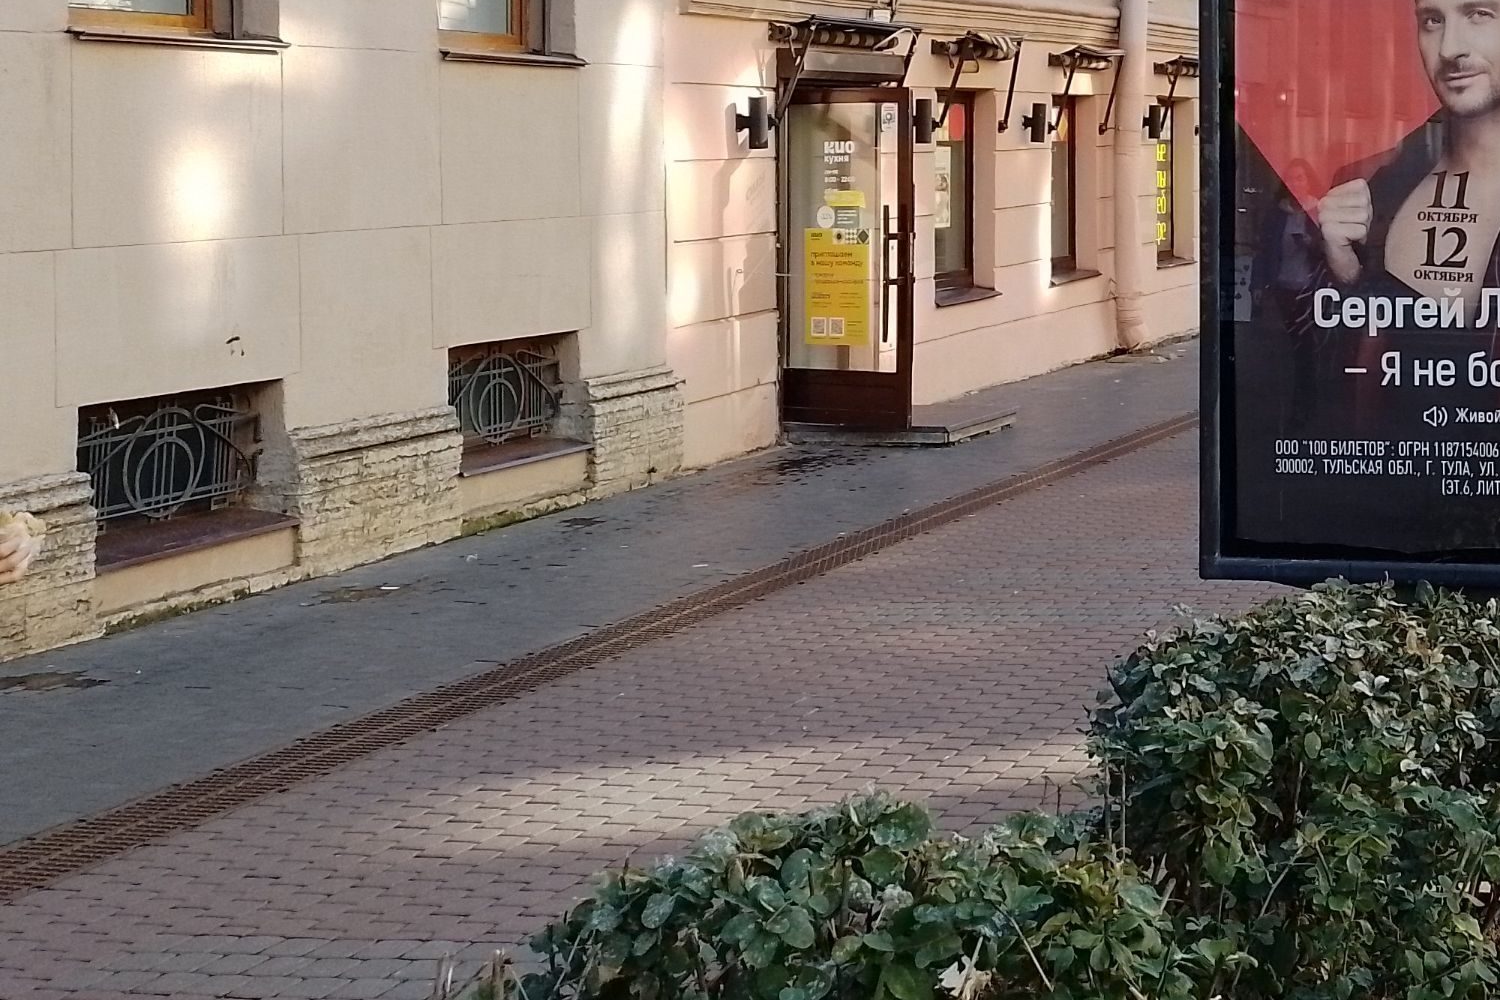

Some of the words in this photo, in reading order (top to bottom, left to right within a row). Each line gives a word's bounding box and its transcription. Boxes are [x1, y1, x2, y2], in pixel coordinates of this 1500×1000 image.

[1426, 170, 1470, 210] 11
[1417, 211, 1479, 223] ОКТЯБРЯ
[1420, 226, 1468, 268] 12
[1413, 269, 1474, 282] ОКТЯБРЯ
[1313, 287, 1465, 337] Сергей
[1380, 352, 1401, 387] Я
[1413, 358, 1456, 387] не
[1275, 440, 1299, 455] ООО
[1398, 442, 1430, 457] ОГРН
[1275, 458, 1318, 476] 300002,
[1322, 459, 1383, 475] ТУЛЬСКАЯ
[1388, 460, 1421, 477] ОБЛ.,
[1425, 461, 1436, 475] Г.
[1440, 461, 1474, 478] ТУЛА,
[1479, 462, 1499, 477] УЛ.
[1441, 479, 1474, 496] (ЭТ.6,
